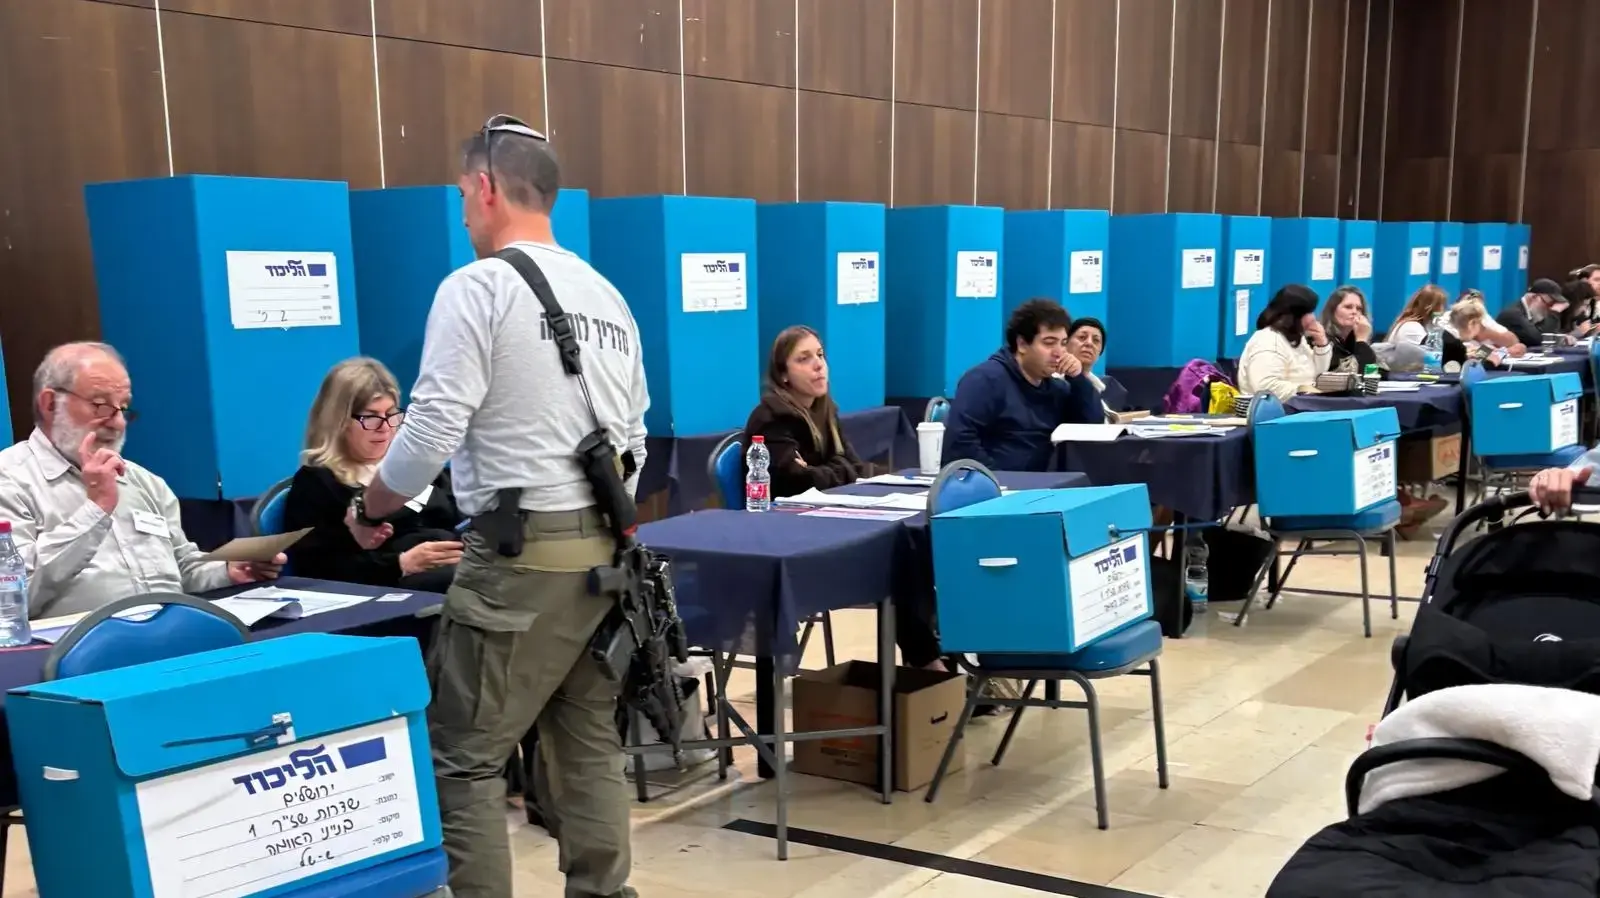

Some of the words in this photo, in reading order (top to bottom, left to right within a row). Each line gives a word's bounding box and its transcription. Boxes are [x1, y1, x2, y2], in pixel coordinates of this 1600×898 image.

[264, 259, 307, 277] הליכוד
[540, 312, 589, 342] לוחה
[592, 318, 629, 357] מדריך
[1094, 547, 1123, 575] הליכוד
[232, 744, 338, 795] הליכוד
[283, 784, 334, 808] ירושלים
[314, 798, 360, 821] שדרות
[248, 824, 257, 837] 1
[266, 832, 313, 856] האומה
